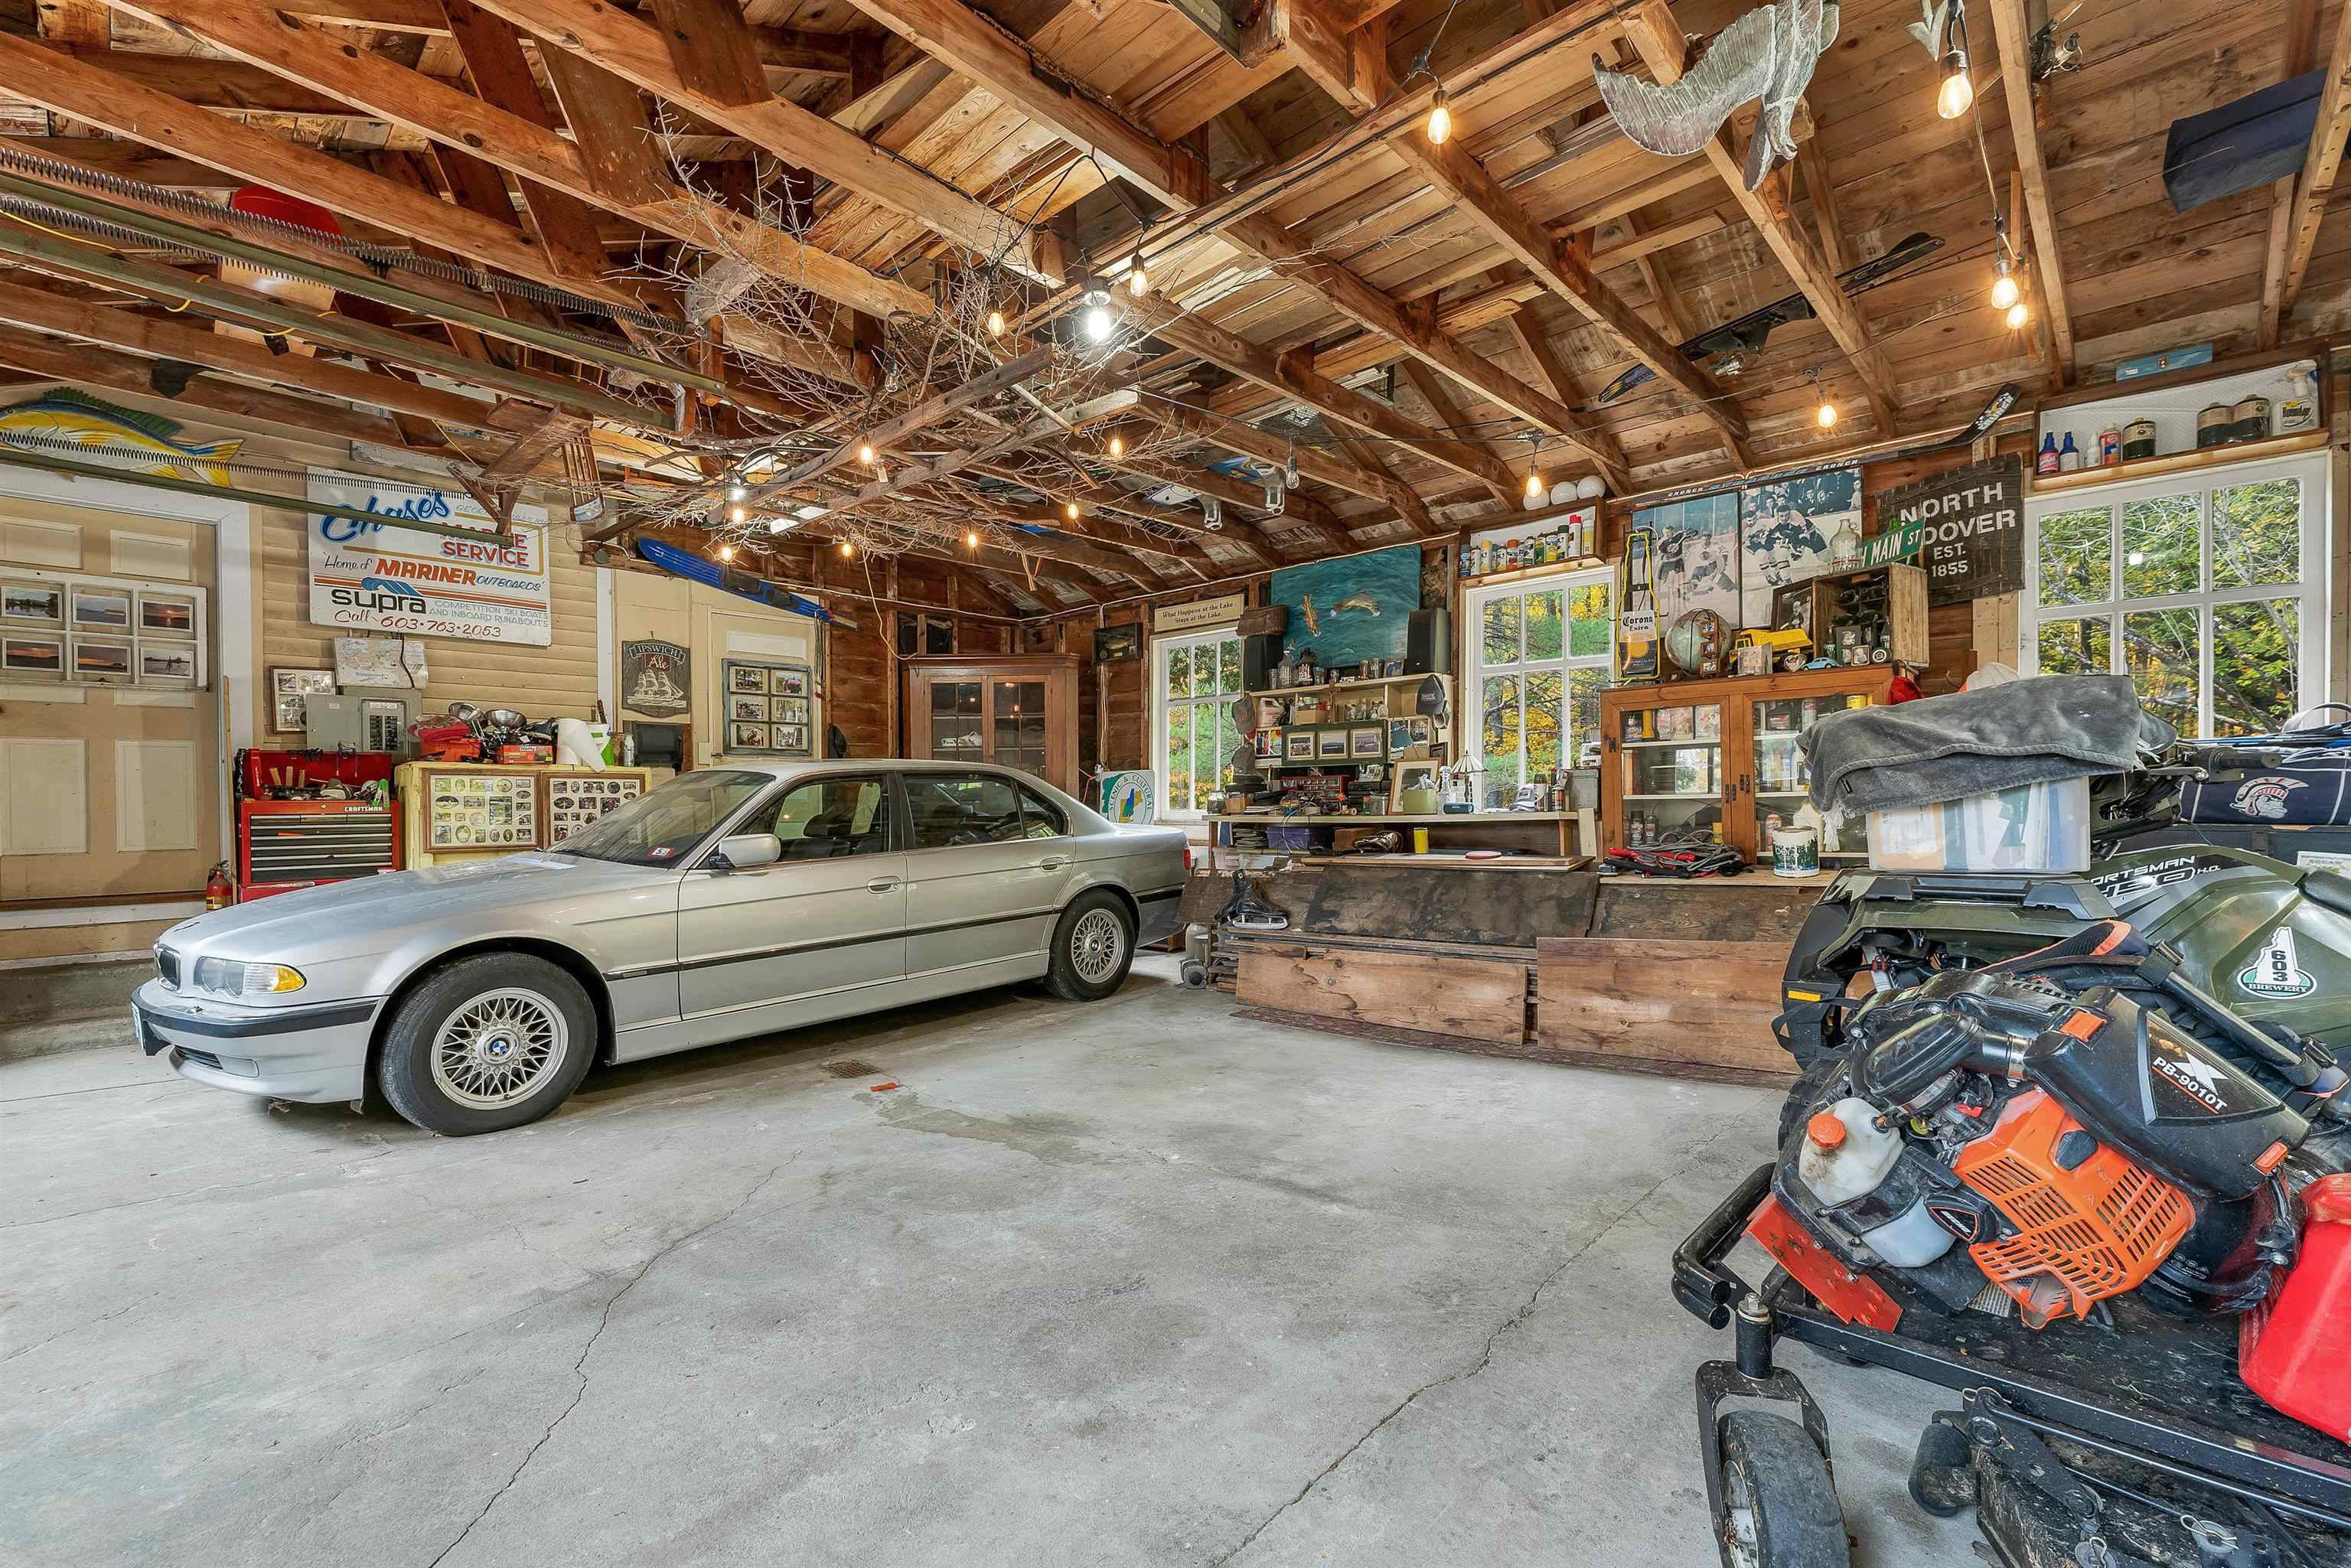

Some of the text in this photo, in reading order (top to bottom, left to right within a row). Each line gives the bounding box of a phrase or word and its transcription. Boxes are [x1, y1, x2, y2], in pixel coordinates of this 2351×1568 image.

[1900, 483, 2003, 526] NORTH
[1923, 510, 2016, 545] DOVER
[441, 541, 529, 568] SERVICE
[1870, 531, 1903, 566] MAIN
[1908, 530, 1921, 545] ST
[1934, 543, 1965, 559] EST.
[360, 558, 373, 570] of
[375, 558, 477, 586] MARINER
[1932, 560, 1968, 577] 1855
[331, 588, 426, 614] supra
[434, 600, 549, 620] COMPETITION SKI BOATS
[429, 608, 549, 628] AND INBOARD RUNABOUTS
[1623, 616, 1653, 626] Corona
[637, 644, 678, 657] IPSWICH
[648, 654, 670, 670] Ale
[1109, 782, 1122, 811] SCENIC
[1132, 774, 1153, 810] CULTURAL
[2090, 855, 2195, 885] ORTSMAN
[2271, 950, 2288, 982] 603
[2248, 983, 2307, 993] BREWERY
[2153, 1056, 2228, 1110] PB-9010T
